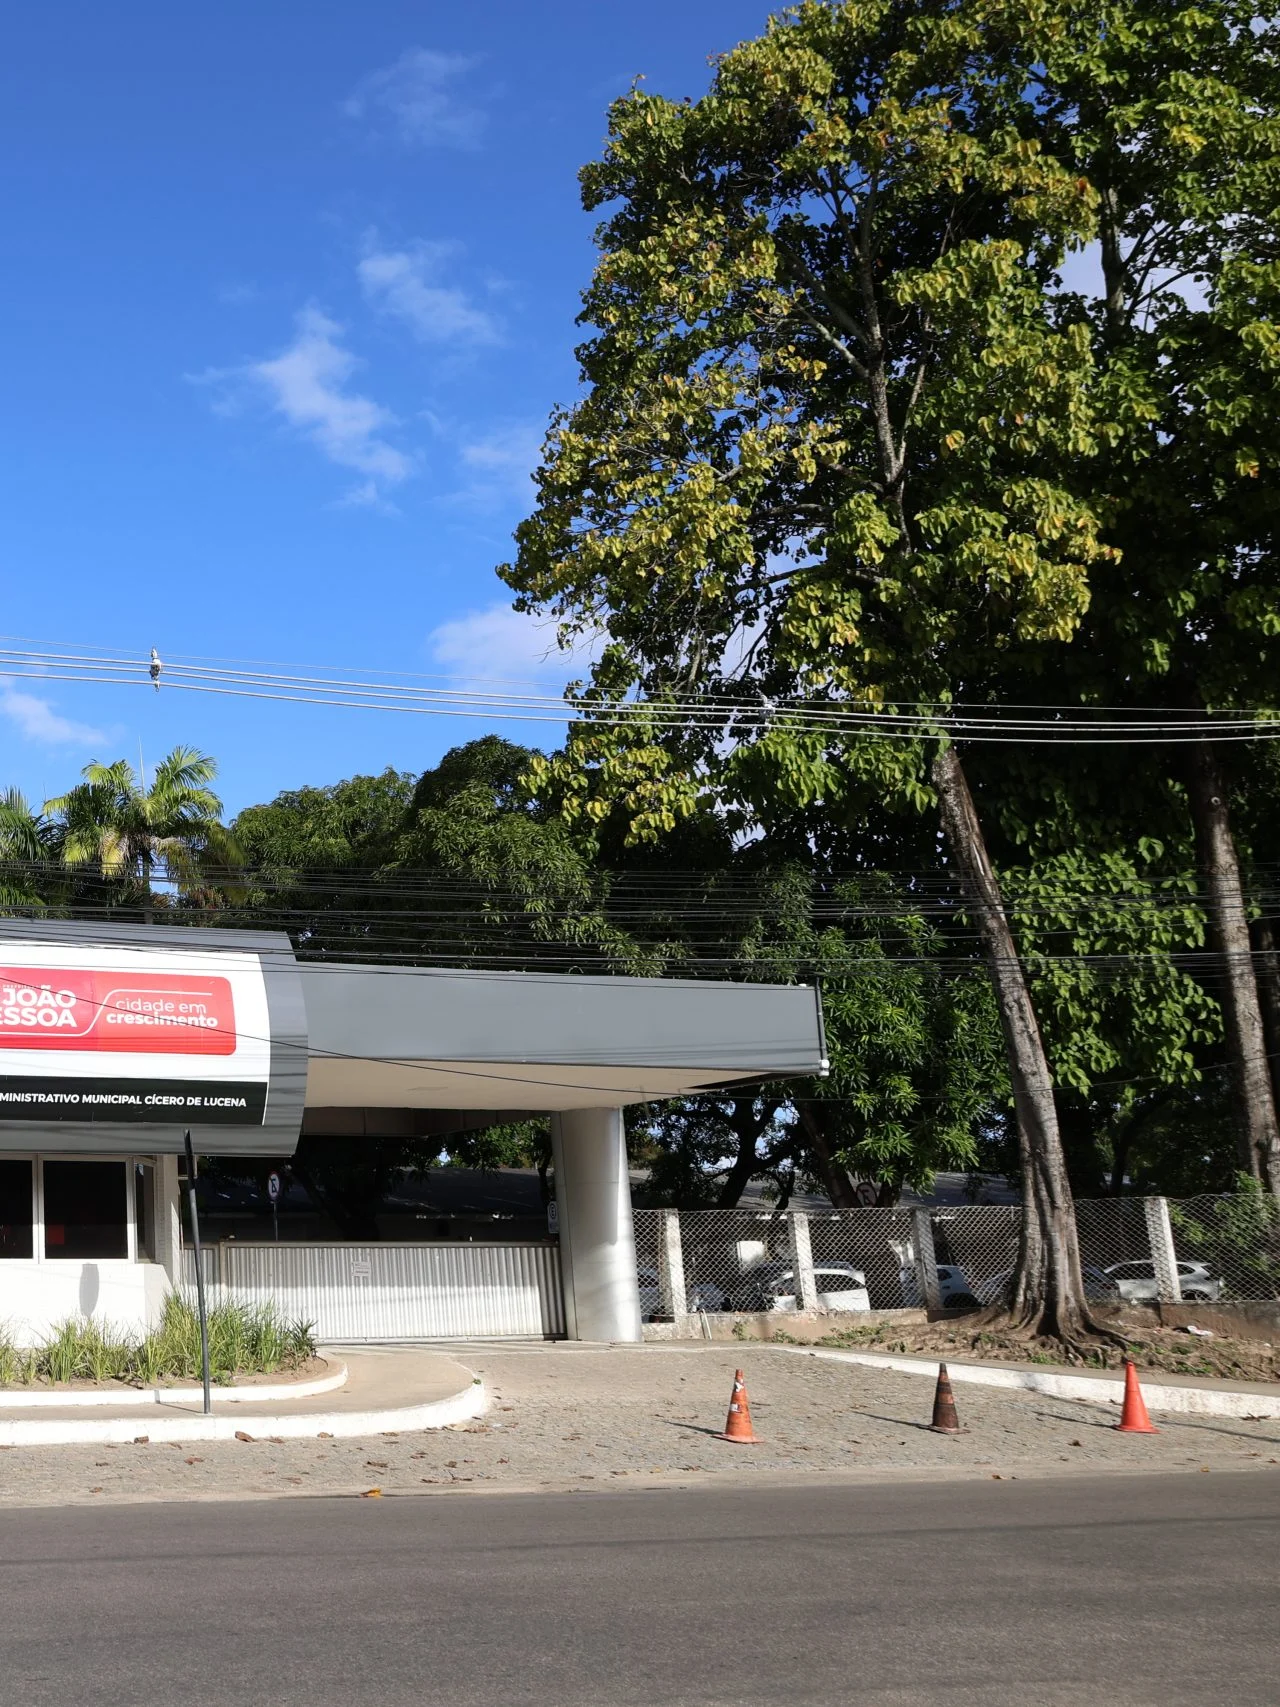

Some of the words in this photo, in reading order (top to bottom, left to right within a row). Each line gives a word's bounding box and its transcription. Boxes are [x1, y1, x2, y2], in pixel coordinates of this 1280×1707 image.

[2, 984, 77, 1008] JOÃO
[116, 998, 175, 1013] cidade
[179, 1002, 207, 1014] em
[106, 1011, 219, 1028] crescimento
[82, 1094, 142, 1105] MUNICIPAL
[144, 1094, 185, 1106] CÍCERO
[187, 1096, 202, 1106] DE
[204, 1097, 247, 1107] LUCENA
